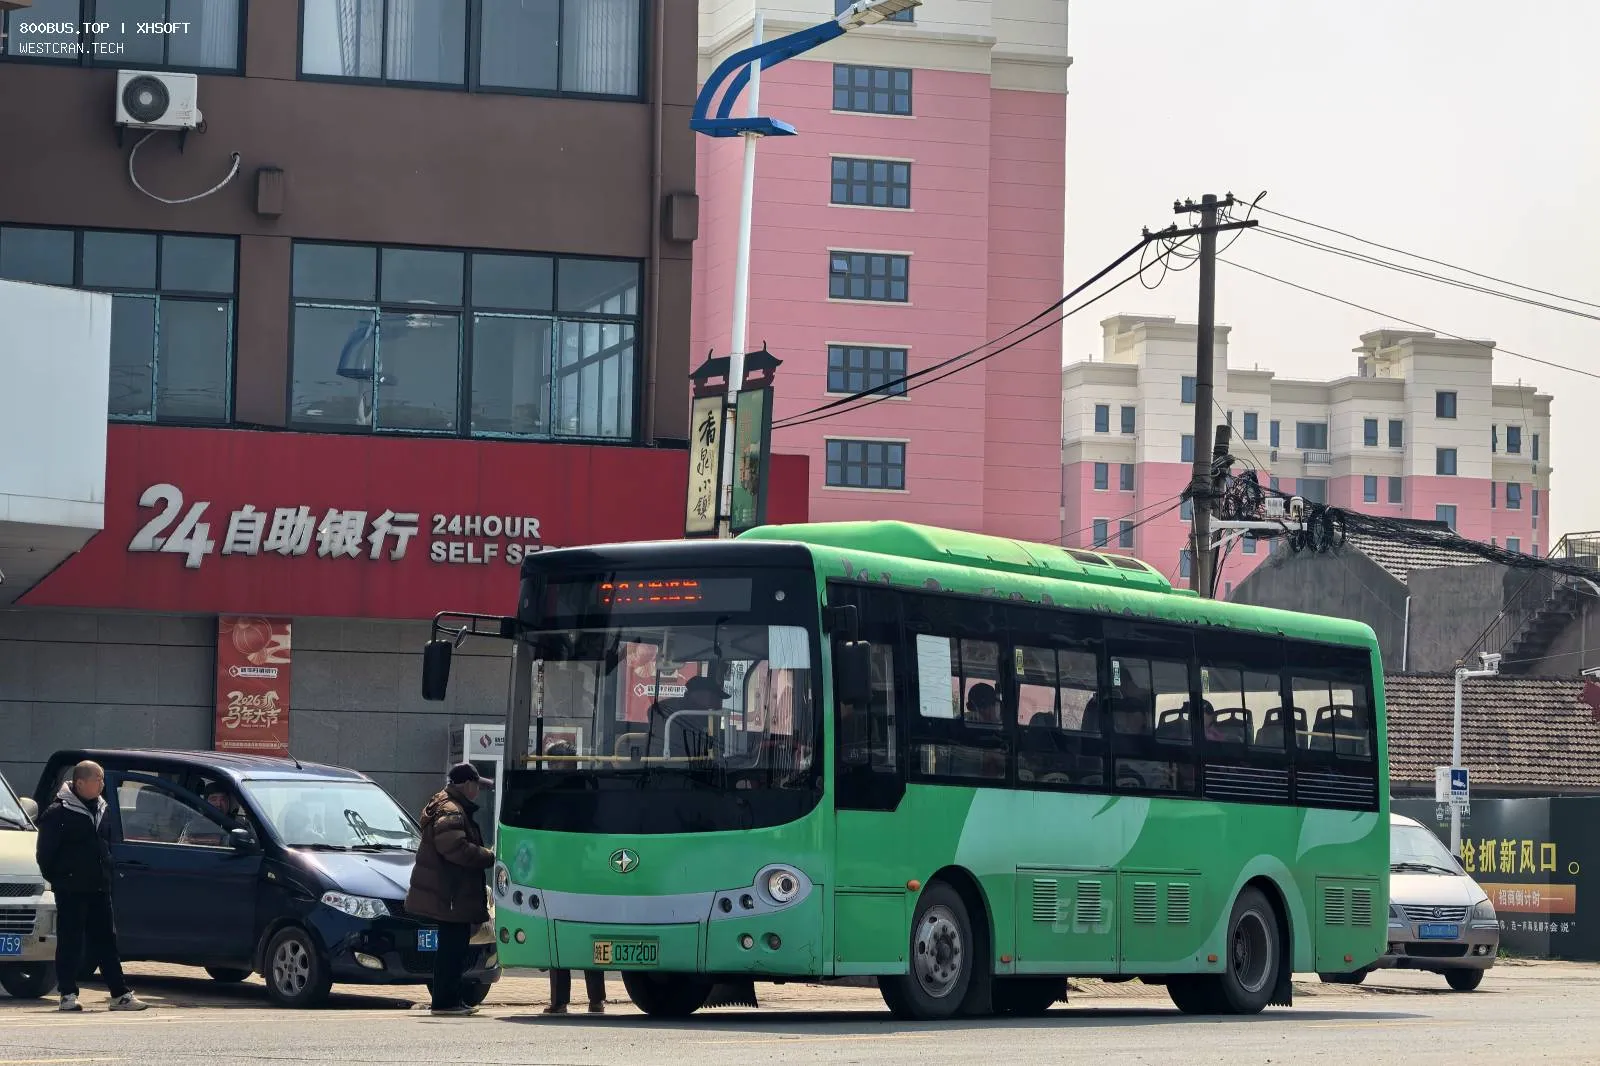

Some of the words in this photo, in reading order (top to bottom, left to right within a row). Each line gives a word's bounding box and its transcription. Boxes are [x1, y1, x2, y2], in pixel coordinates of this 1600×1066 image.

[432, 514, 541, 539] 24HOUR
[430, 542, 499, 565] SELF
[227, 691, 261, 706] 2026
[221, 706, 282, 728] 马年大吉
